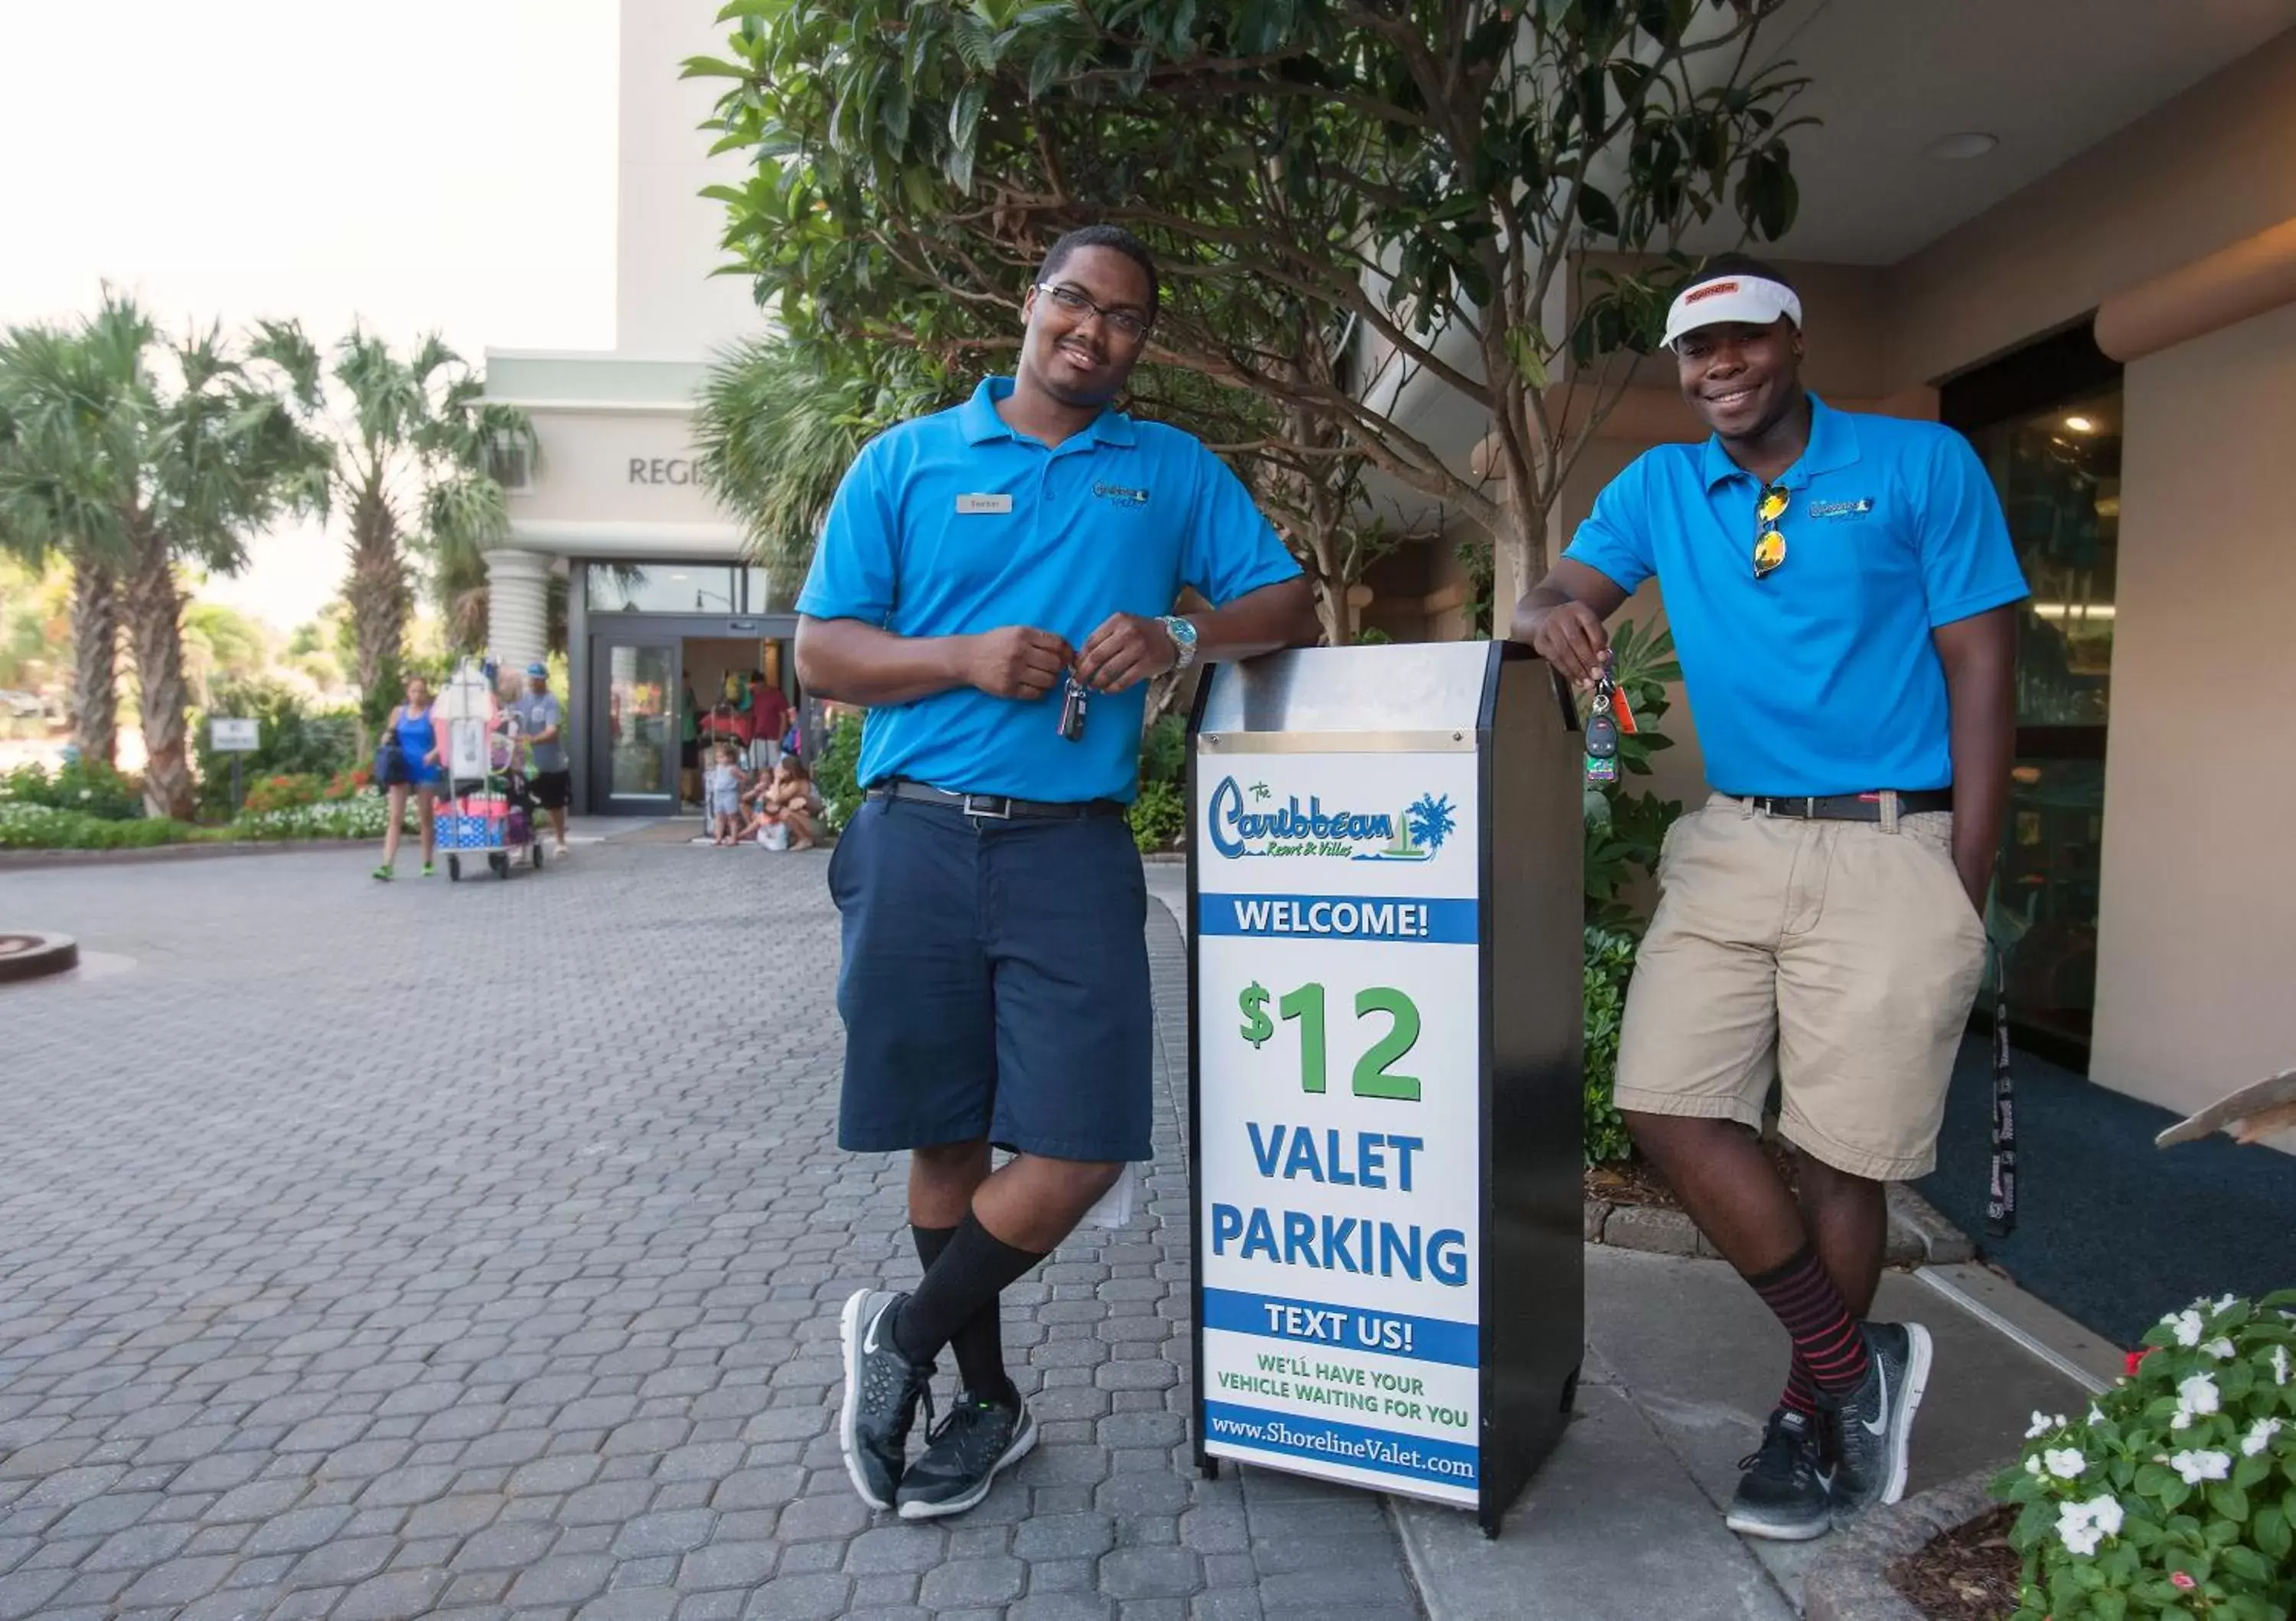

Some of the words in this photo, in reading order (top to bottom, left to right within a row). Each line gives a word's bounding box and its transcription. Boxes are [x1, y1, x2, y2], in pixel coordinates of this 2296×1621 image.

[1208, 775, 1394, 859] Caribbean
[1249, 781, 1271, 802] The
[1267, 841, 1303, 856] Resort
[1304, 841, 1317, 856] &
[1318, 841, 1353, 857] Villas
[1234, 900, 1429, 935] WELCOME!
[1238, 980, 1421, 1102] $12
[1246, 1121, 1424, 1192] VALET
[1212, 1202, 1468, 1287] PARKING
[1264, 1303, 1348, 1342] TEXT
[1358, 1319, 1412, 1351] US!
[1218, 1371, 1290, 1398] VEHICLE
[1294, 1384, 1378, 1412] WAITING
[1384, 1398, 1422, 1420] FOR
[1426, 1405, 1469, 1428] YOU
[1316, 1364, 1365, 1386] HAVE
[1371, 1372, 1424, 1397] YOUR
[1212, 1416, 1475, 1479] www.ShorelineValet.com
